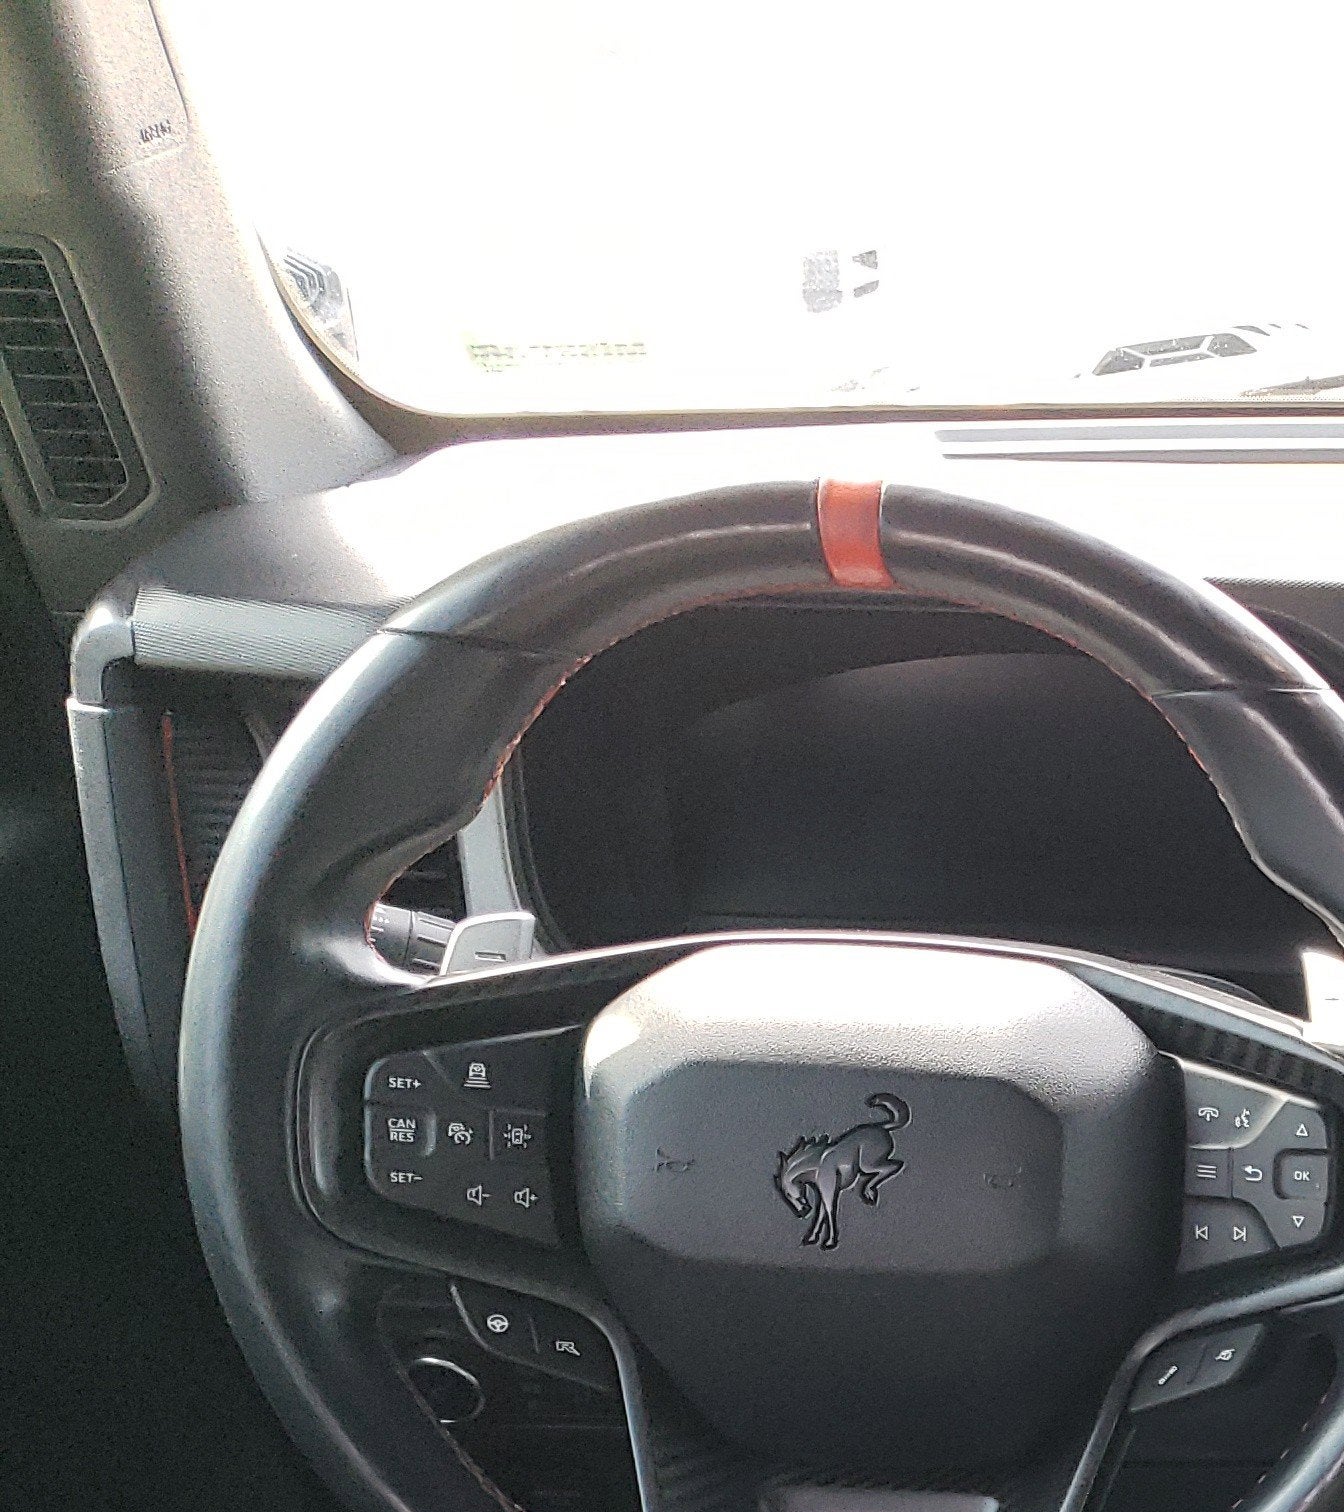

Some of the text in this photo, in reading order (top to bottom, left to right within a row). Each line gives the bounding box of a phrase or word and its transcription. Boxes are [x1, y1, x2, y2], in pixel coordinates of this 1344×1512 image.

[388, 1118, 416, 1129] CAN
[389, 1131, 415, 1143] RES
[1294, 1170, 1310, 1181] OK
